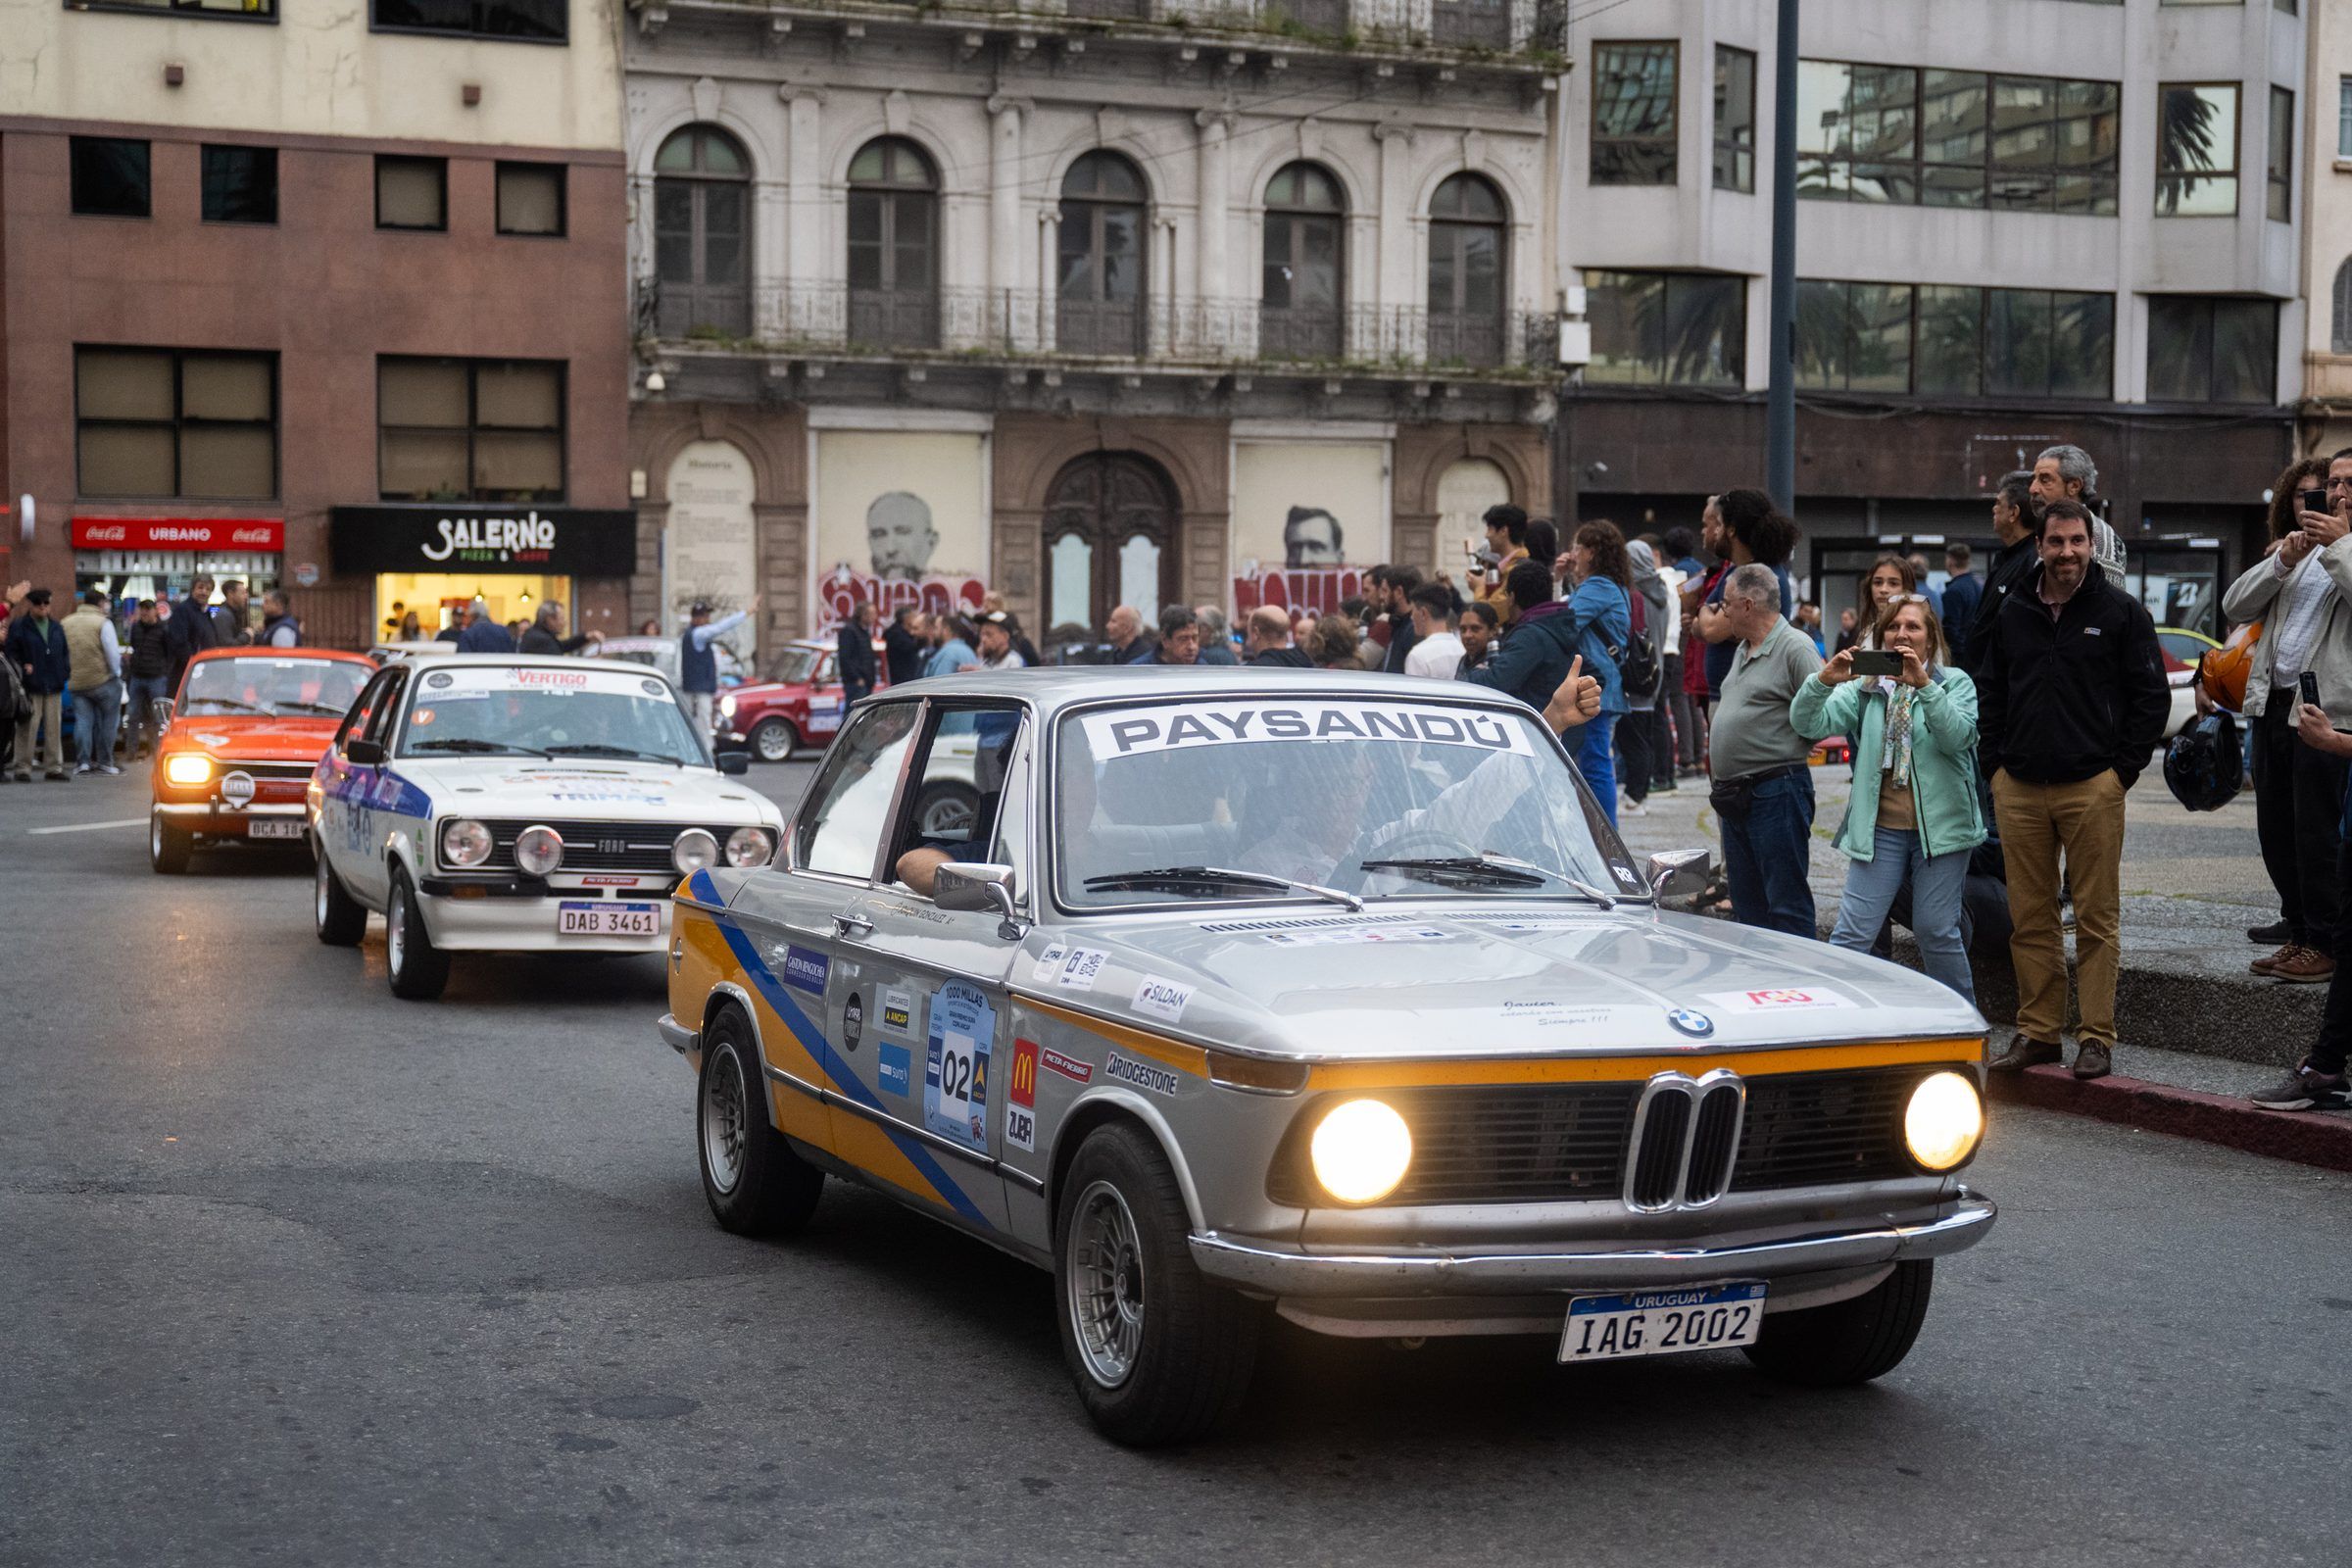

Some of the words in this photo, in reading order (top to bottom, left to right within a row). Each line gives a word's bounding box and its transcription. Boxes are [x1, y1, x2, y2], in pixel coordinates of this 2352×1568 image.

[85, 525, 125, 541] Coca-Cola
[149, 527, 212, 541] URBANO
[232, 527, 271, 543] Coca-Cola
[421, 511, 556, 561] SALERNO
[460, 550, 494, 562] PIZZA
[517, 668, 587, 686] VERTIGO
[1109, 709, 1513, 752] PAYSANDÚ
[599, 839, 625, 854] FORD
[1612, 865, 1638, 884] RR
[591, 903, 629, 912] URUGUAY
[565, 912, 600, 931] DAB
[609, 912, 654, 932] 3461
[946, 986, 960, 1000] 1000
[960, 988, 983, 1008] MILLAS
[1150, 985, 1189, 1007] SILDAN
[891, 1011, 907, 1024] ANCAP
[1538, 1017, 1587, 1026] Siempre
[1045, 1054, 1063, 1067] META
[1062, 1061, 1089, 1076] FIERRO
[943, 1050, 970, 1102] 02
[1107, 1054, 1177, 1095] BRIDGESTONE
[1635, 1292, 1708, 1309] URUGUAY
[1576, 1314, 1646, 1355] IAG
[1660, 1305, 1752, 1348] 2002
